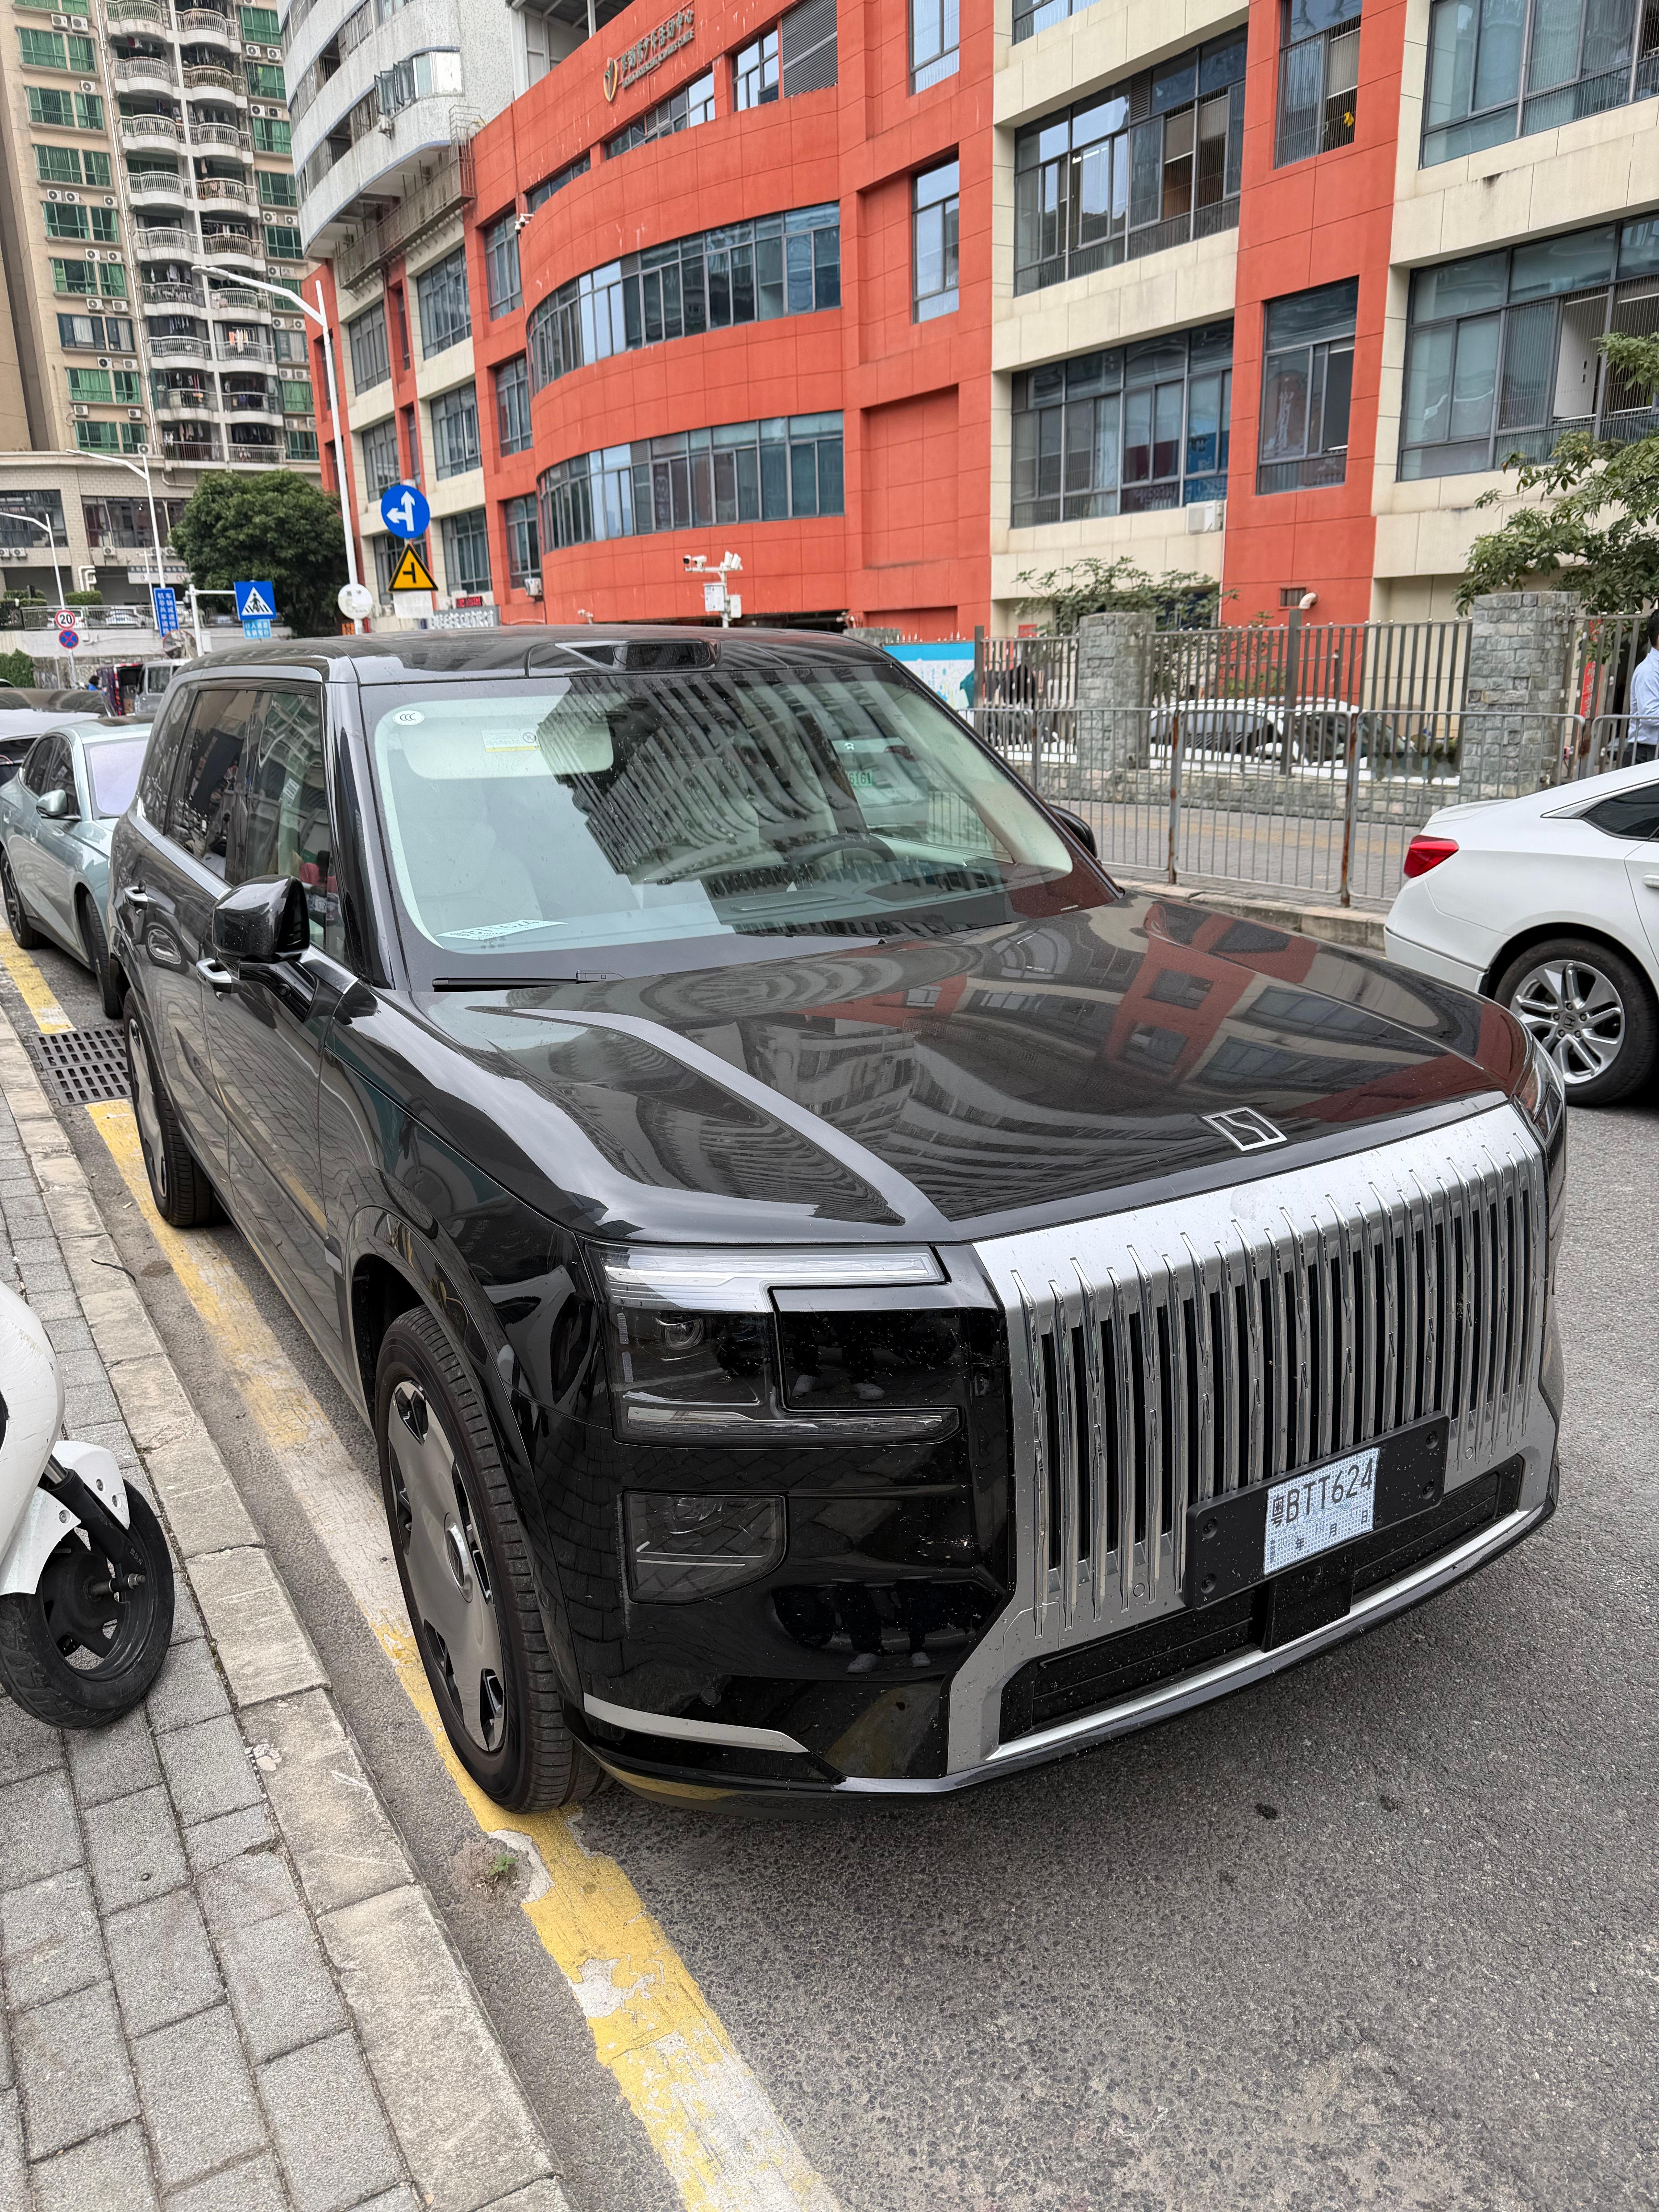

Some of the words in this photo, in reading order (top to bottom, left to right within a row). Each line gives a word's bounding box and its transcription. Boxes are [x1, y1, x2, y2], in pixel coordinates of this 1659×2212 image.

[60, 614, 72, 624] 20
[400, 713, 416, 721] CCC
[1271, 1458, 1373, 1528] 粤BTT624
